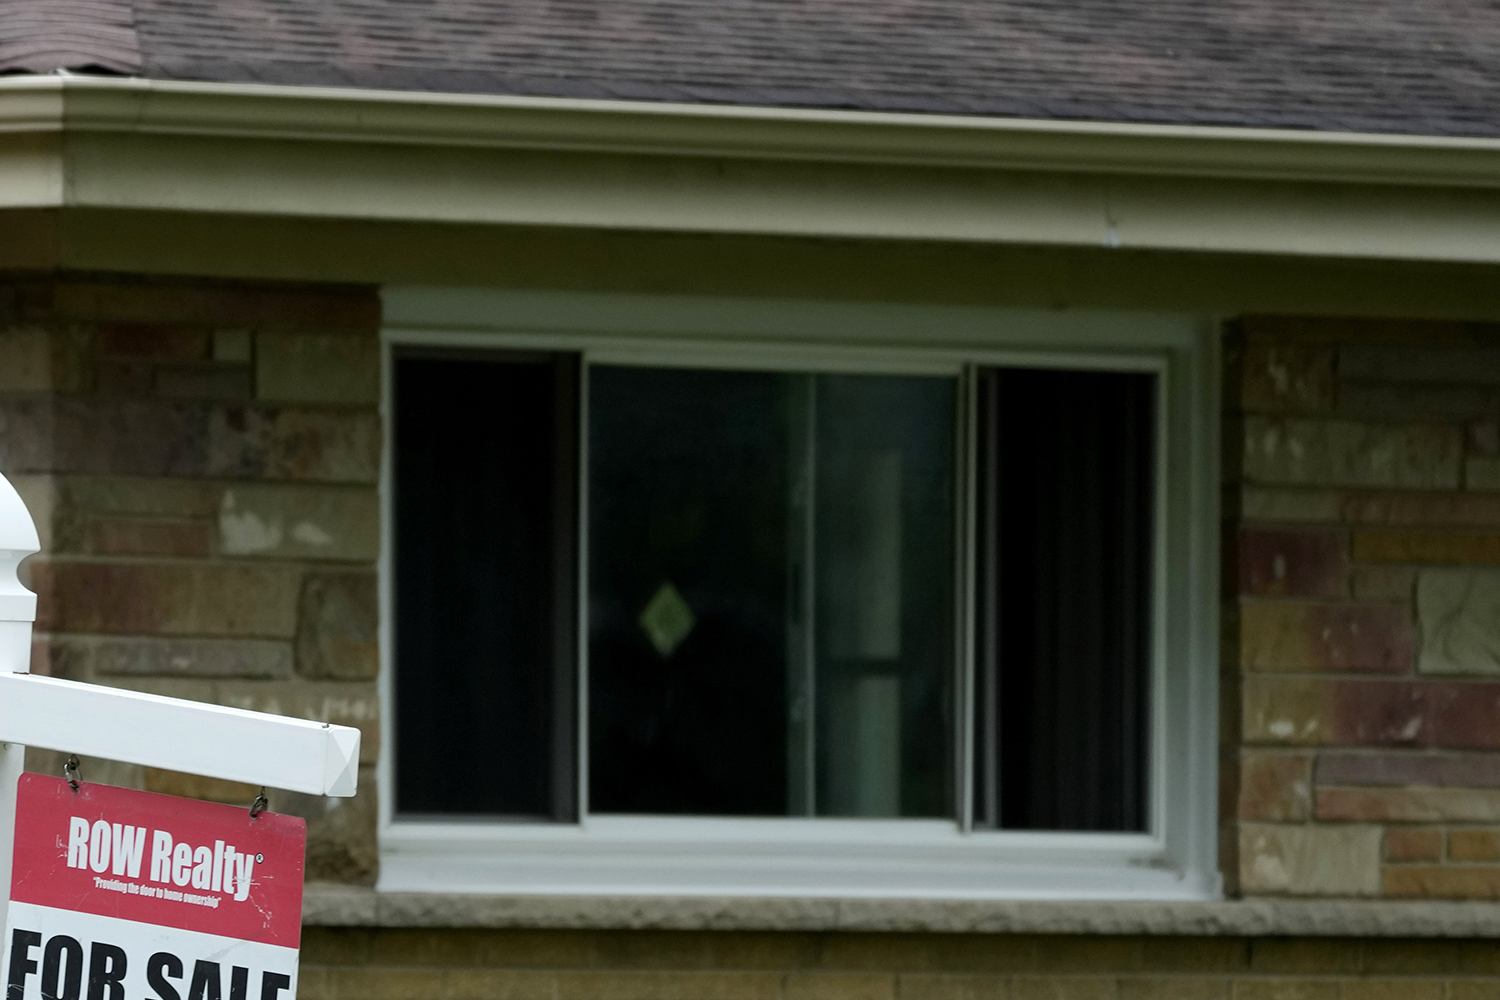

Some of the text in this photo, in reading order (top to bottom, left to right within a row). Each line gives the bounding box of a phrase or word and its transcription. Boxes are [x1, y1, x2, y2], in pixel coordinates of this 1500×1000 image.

[66, 816, 147, 879] ROW
[128, 882, 140, 895] the
[140, 884, 156, 897] door
[156, 887, 164, 899] to
[164, 888, 183, 902] home
